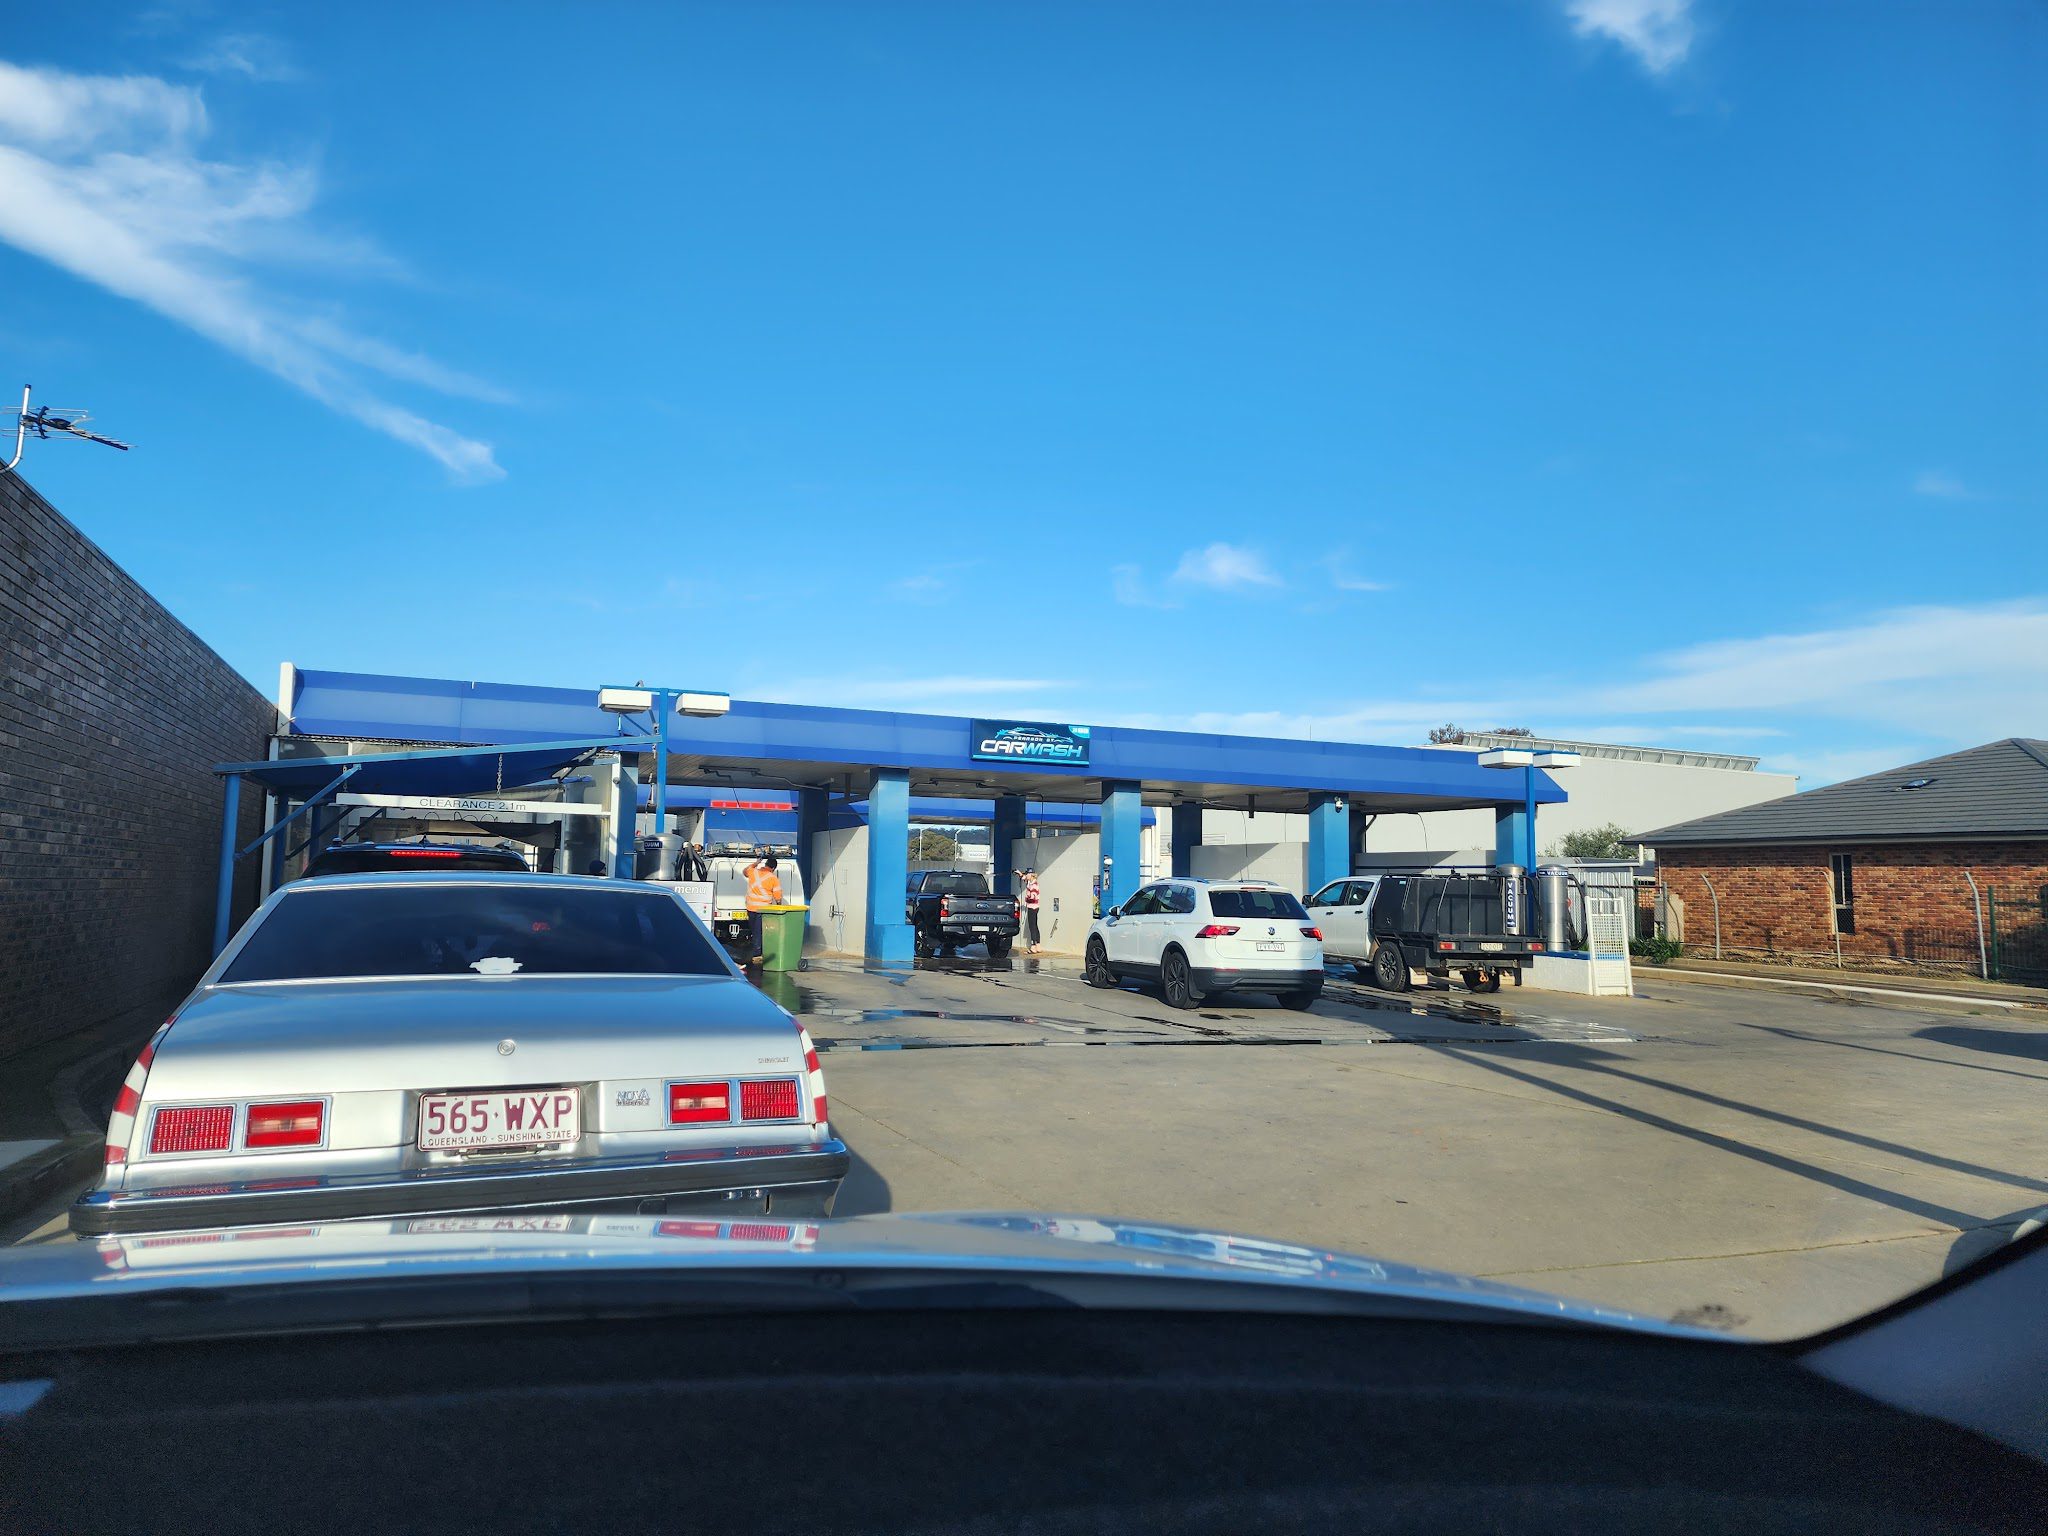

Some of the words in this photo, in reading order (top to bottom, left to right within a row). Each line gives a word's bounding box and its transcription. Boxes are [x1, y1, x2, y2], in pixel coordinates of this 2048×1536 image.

[981, 739, 1083, 757] CARWASH
[420, 798, 495, 810] CLEARANCE
[498, 801, 526, 811] 2.1m
[674, 885, 706, 894] menu
[616, 1088, 650, 1100] NOVA
[428, 1135, 487, 1146] QUEENSLAND
[497, 1131, 541, 1142] SUNSHINE
[546, 1130, 571, 1139] STATE
